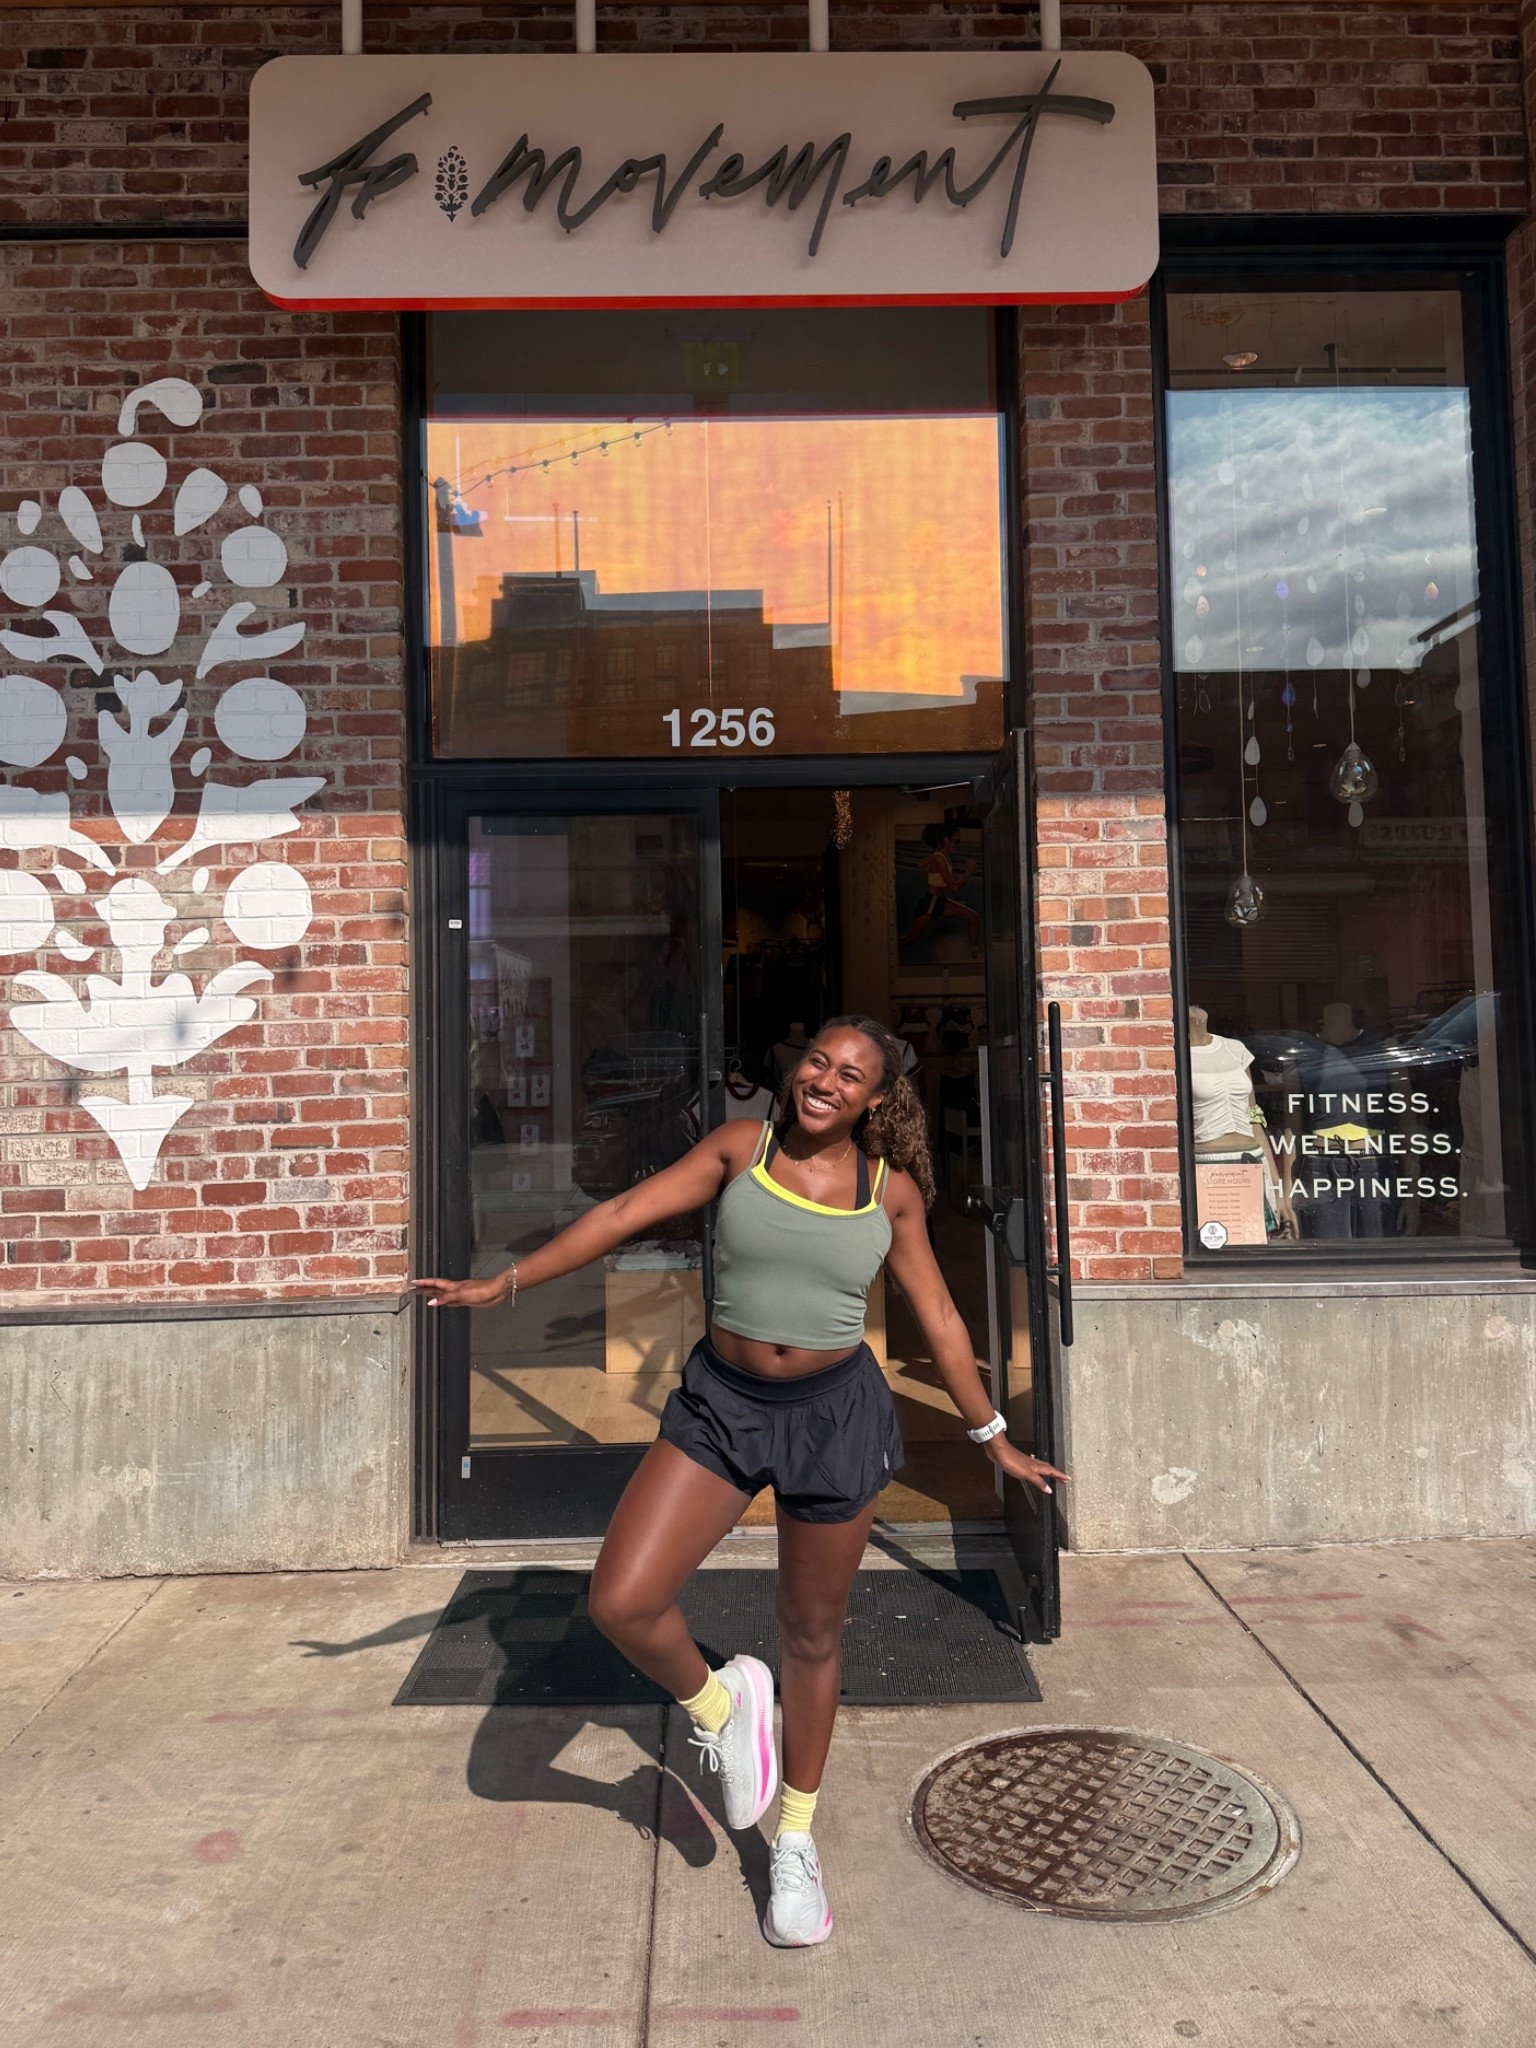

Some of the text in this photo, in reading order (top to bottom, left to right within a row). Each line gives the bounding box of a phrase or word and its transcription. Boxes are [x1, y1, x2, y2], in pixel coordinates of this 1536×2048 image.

[471, 58, 1116, 259] movement
[662, 707, 776, 747] 1256
[1287, 1092, 1439, 1114] FITNESS.
[1269, 1133, 1461, 1155] WELLNESS.
[1265, 1176, 1468, 1198] HAPPINESS.
